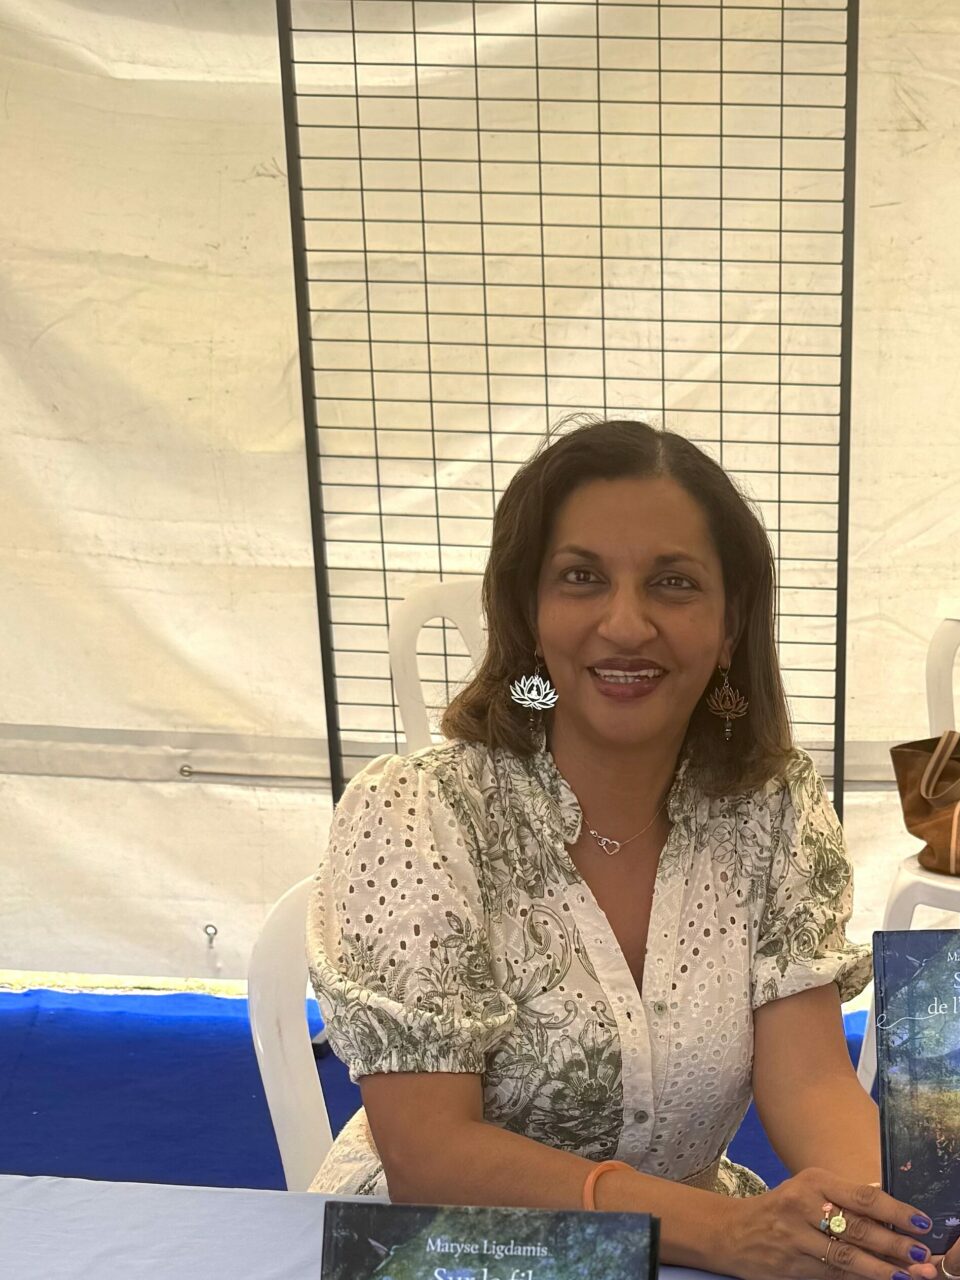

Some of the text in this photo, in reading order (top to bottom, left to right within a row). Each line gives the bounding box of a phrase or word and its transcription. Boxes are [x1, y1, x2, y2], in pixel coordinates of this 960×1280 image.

[927, 997, 948, 1015] de
[426, 1238, 549, 1259] Maryse Ligdamis
